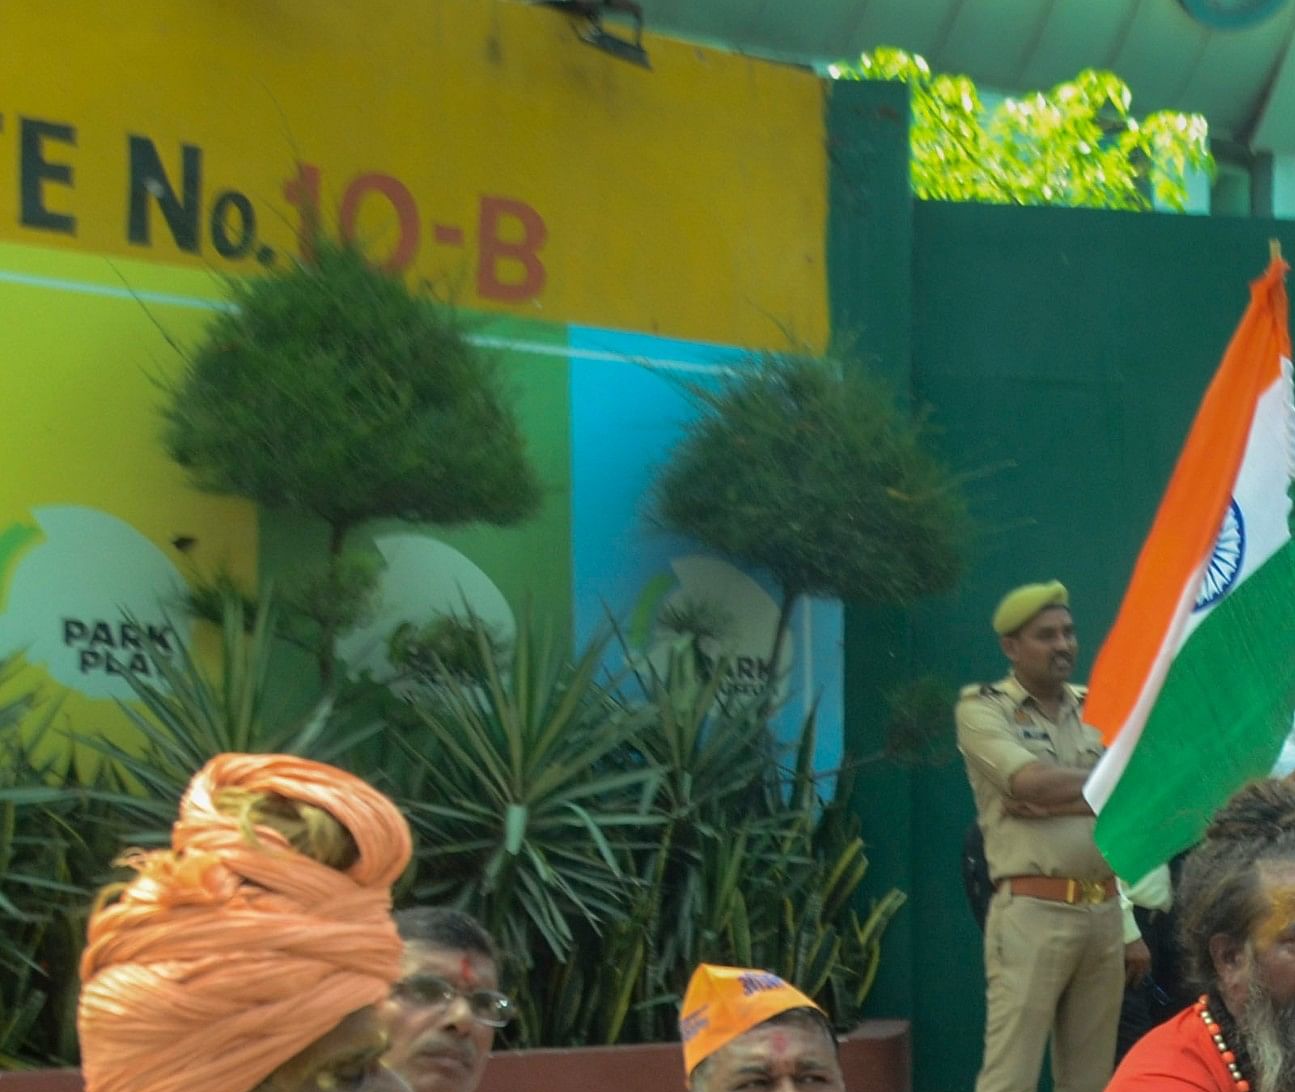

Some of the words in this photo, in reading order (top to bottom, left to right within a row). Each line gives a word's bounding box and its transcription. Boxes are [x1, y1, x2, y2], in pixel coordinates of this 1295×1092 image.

[127, 132, 276, 262] No.
[281, 160, 548, 302] 10-B
[63, 619, 172, 653] PARK
